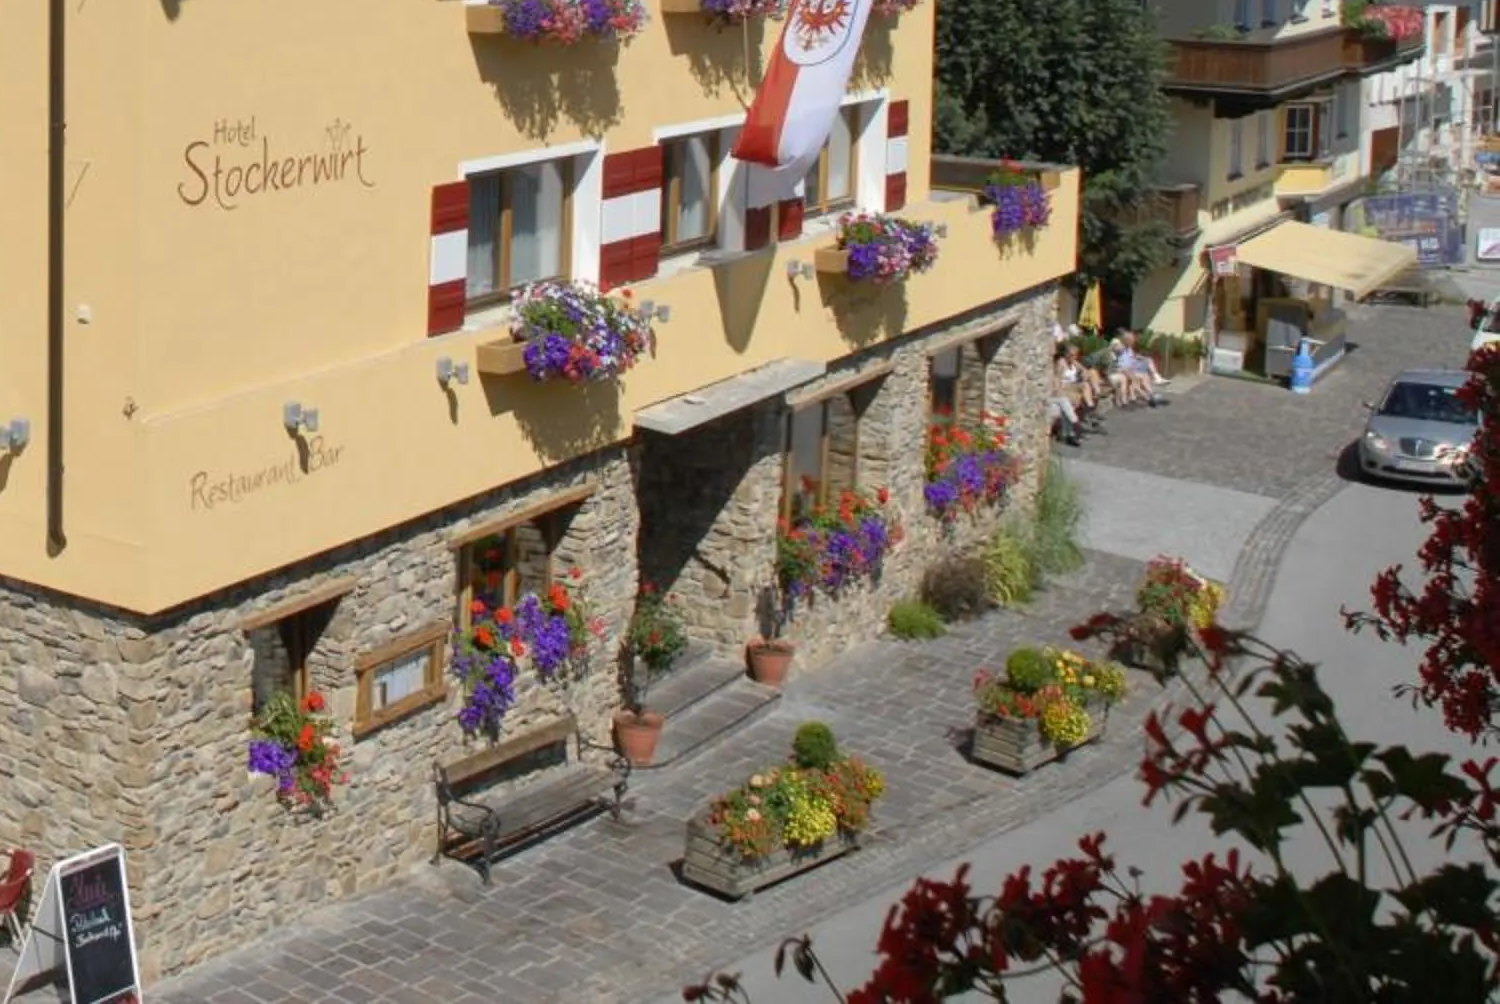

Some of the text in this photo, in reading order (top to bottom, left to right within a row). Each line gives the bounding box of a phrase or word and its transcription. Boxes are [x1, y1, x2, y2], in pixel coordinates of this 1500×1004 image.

[213, 114, 256, 147] Hotel
[177, 135, 376, 211] Stockerwirt
[189, 434, 345, 510] Restaurant Bar
